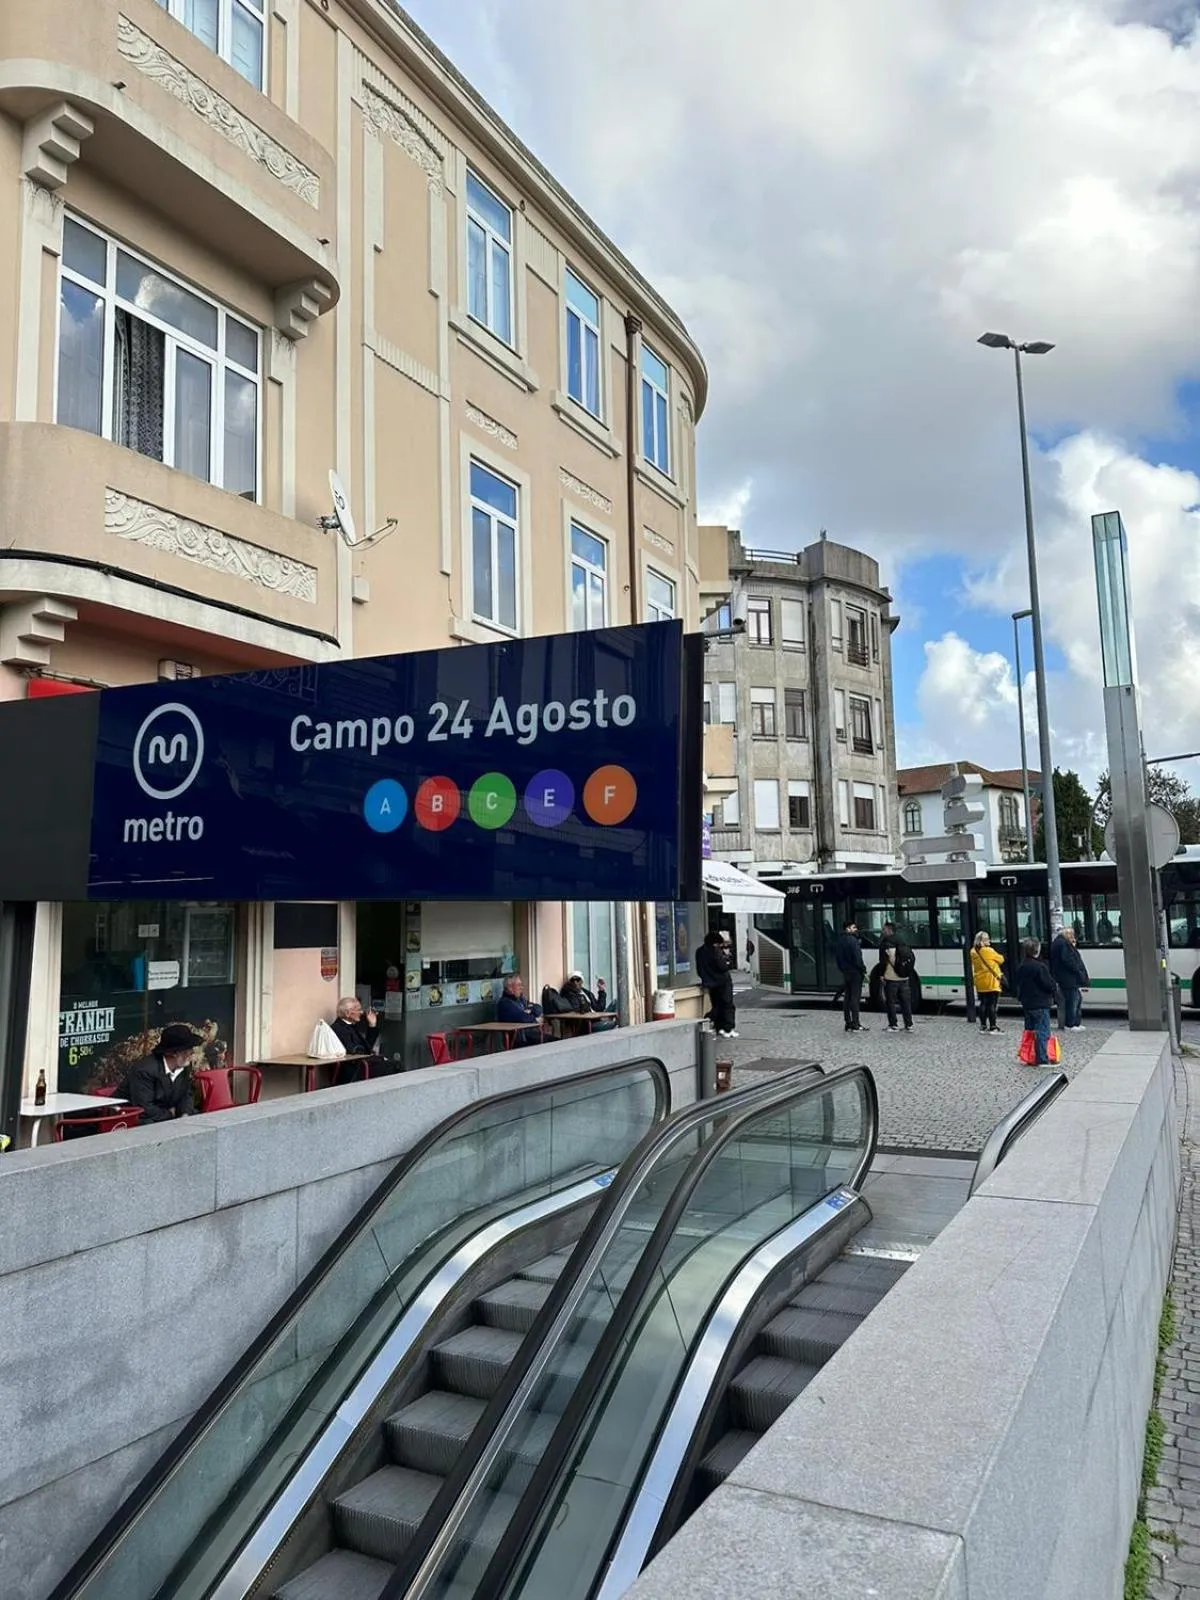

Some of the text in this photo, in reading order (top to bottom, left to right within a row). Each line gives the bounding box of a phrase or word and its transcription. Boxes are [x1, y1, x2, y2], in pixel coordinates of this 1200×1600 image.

[290, 690, 637, 756] Campo 24 Agosto
[379, 785, 617, 816] A B C E F
[123, 811, 204, 843] metro
[59, 1009, 115, 1034] FRANGO
